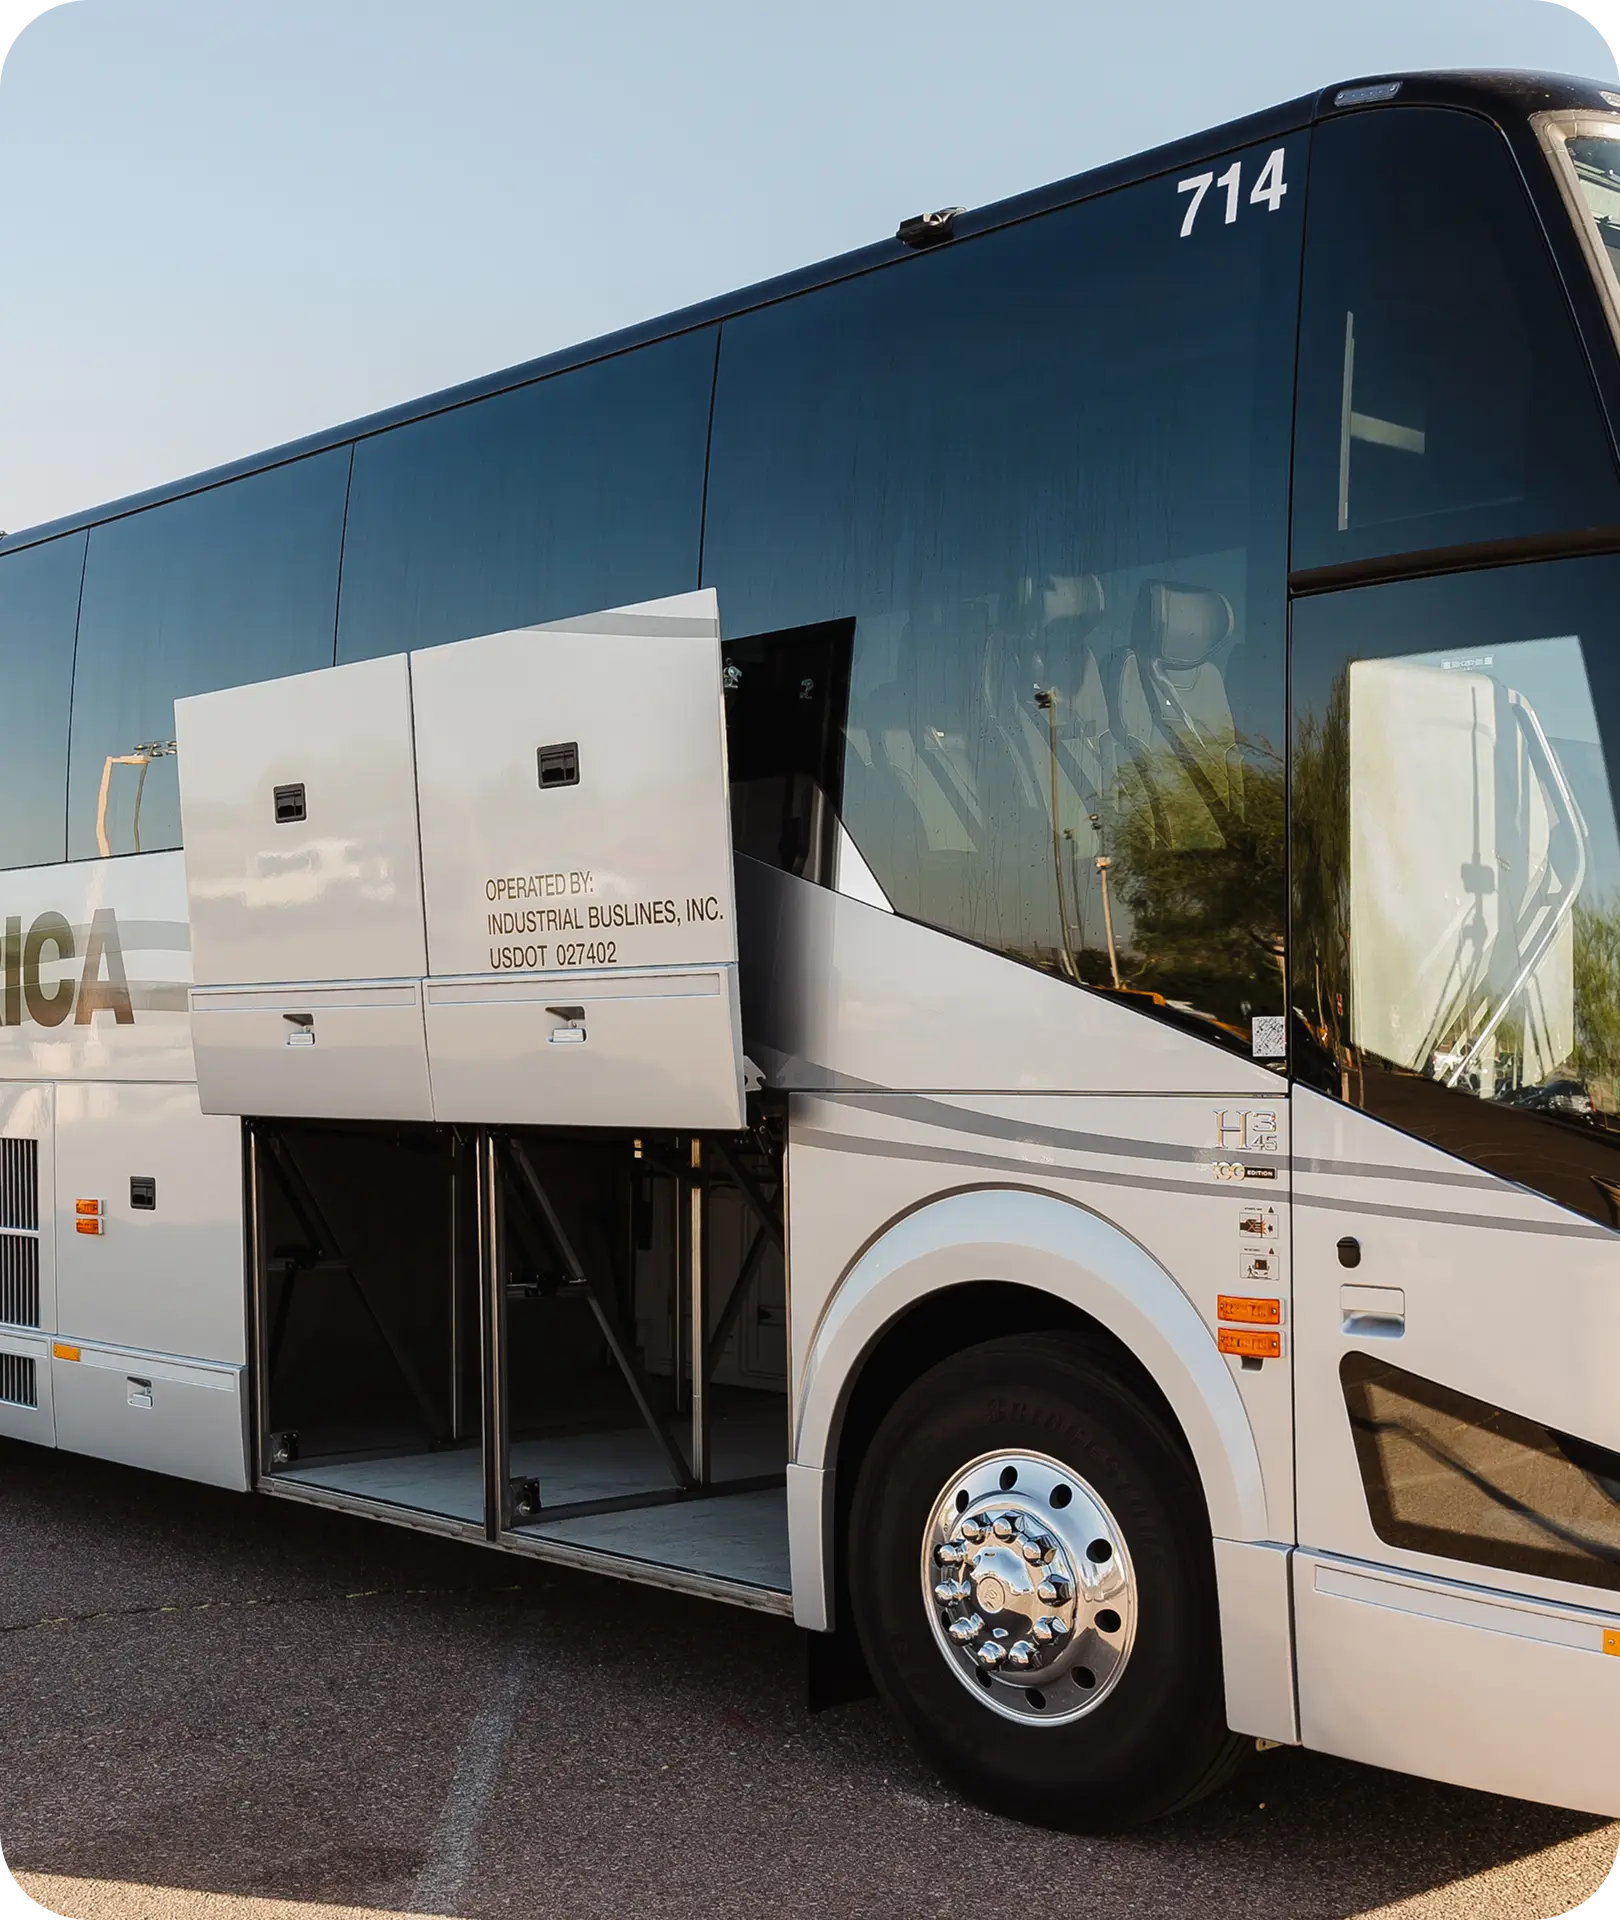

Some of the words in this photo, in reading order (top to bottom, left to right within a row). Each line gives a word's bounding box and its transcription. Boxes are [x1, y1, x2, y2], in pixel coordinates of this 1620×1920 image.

[1177, 147, 1288, 238] 714
[485, 873, 566, 901] OPERATED
[570, 870, 593, 896] BY:
[487, 906, 584, 935] INDUSTRIAL
[588, 899, 681, 928] BUSLINES,
[686, 896, 724, 923] INC.
[0, 908, 135, 1027] ICA
[489, 945, 548, 970] USDOT
[556, 940, 617, 966] 027402
